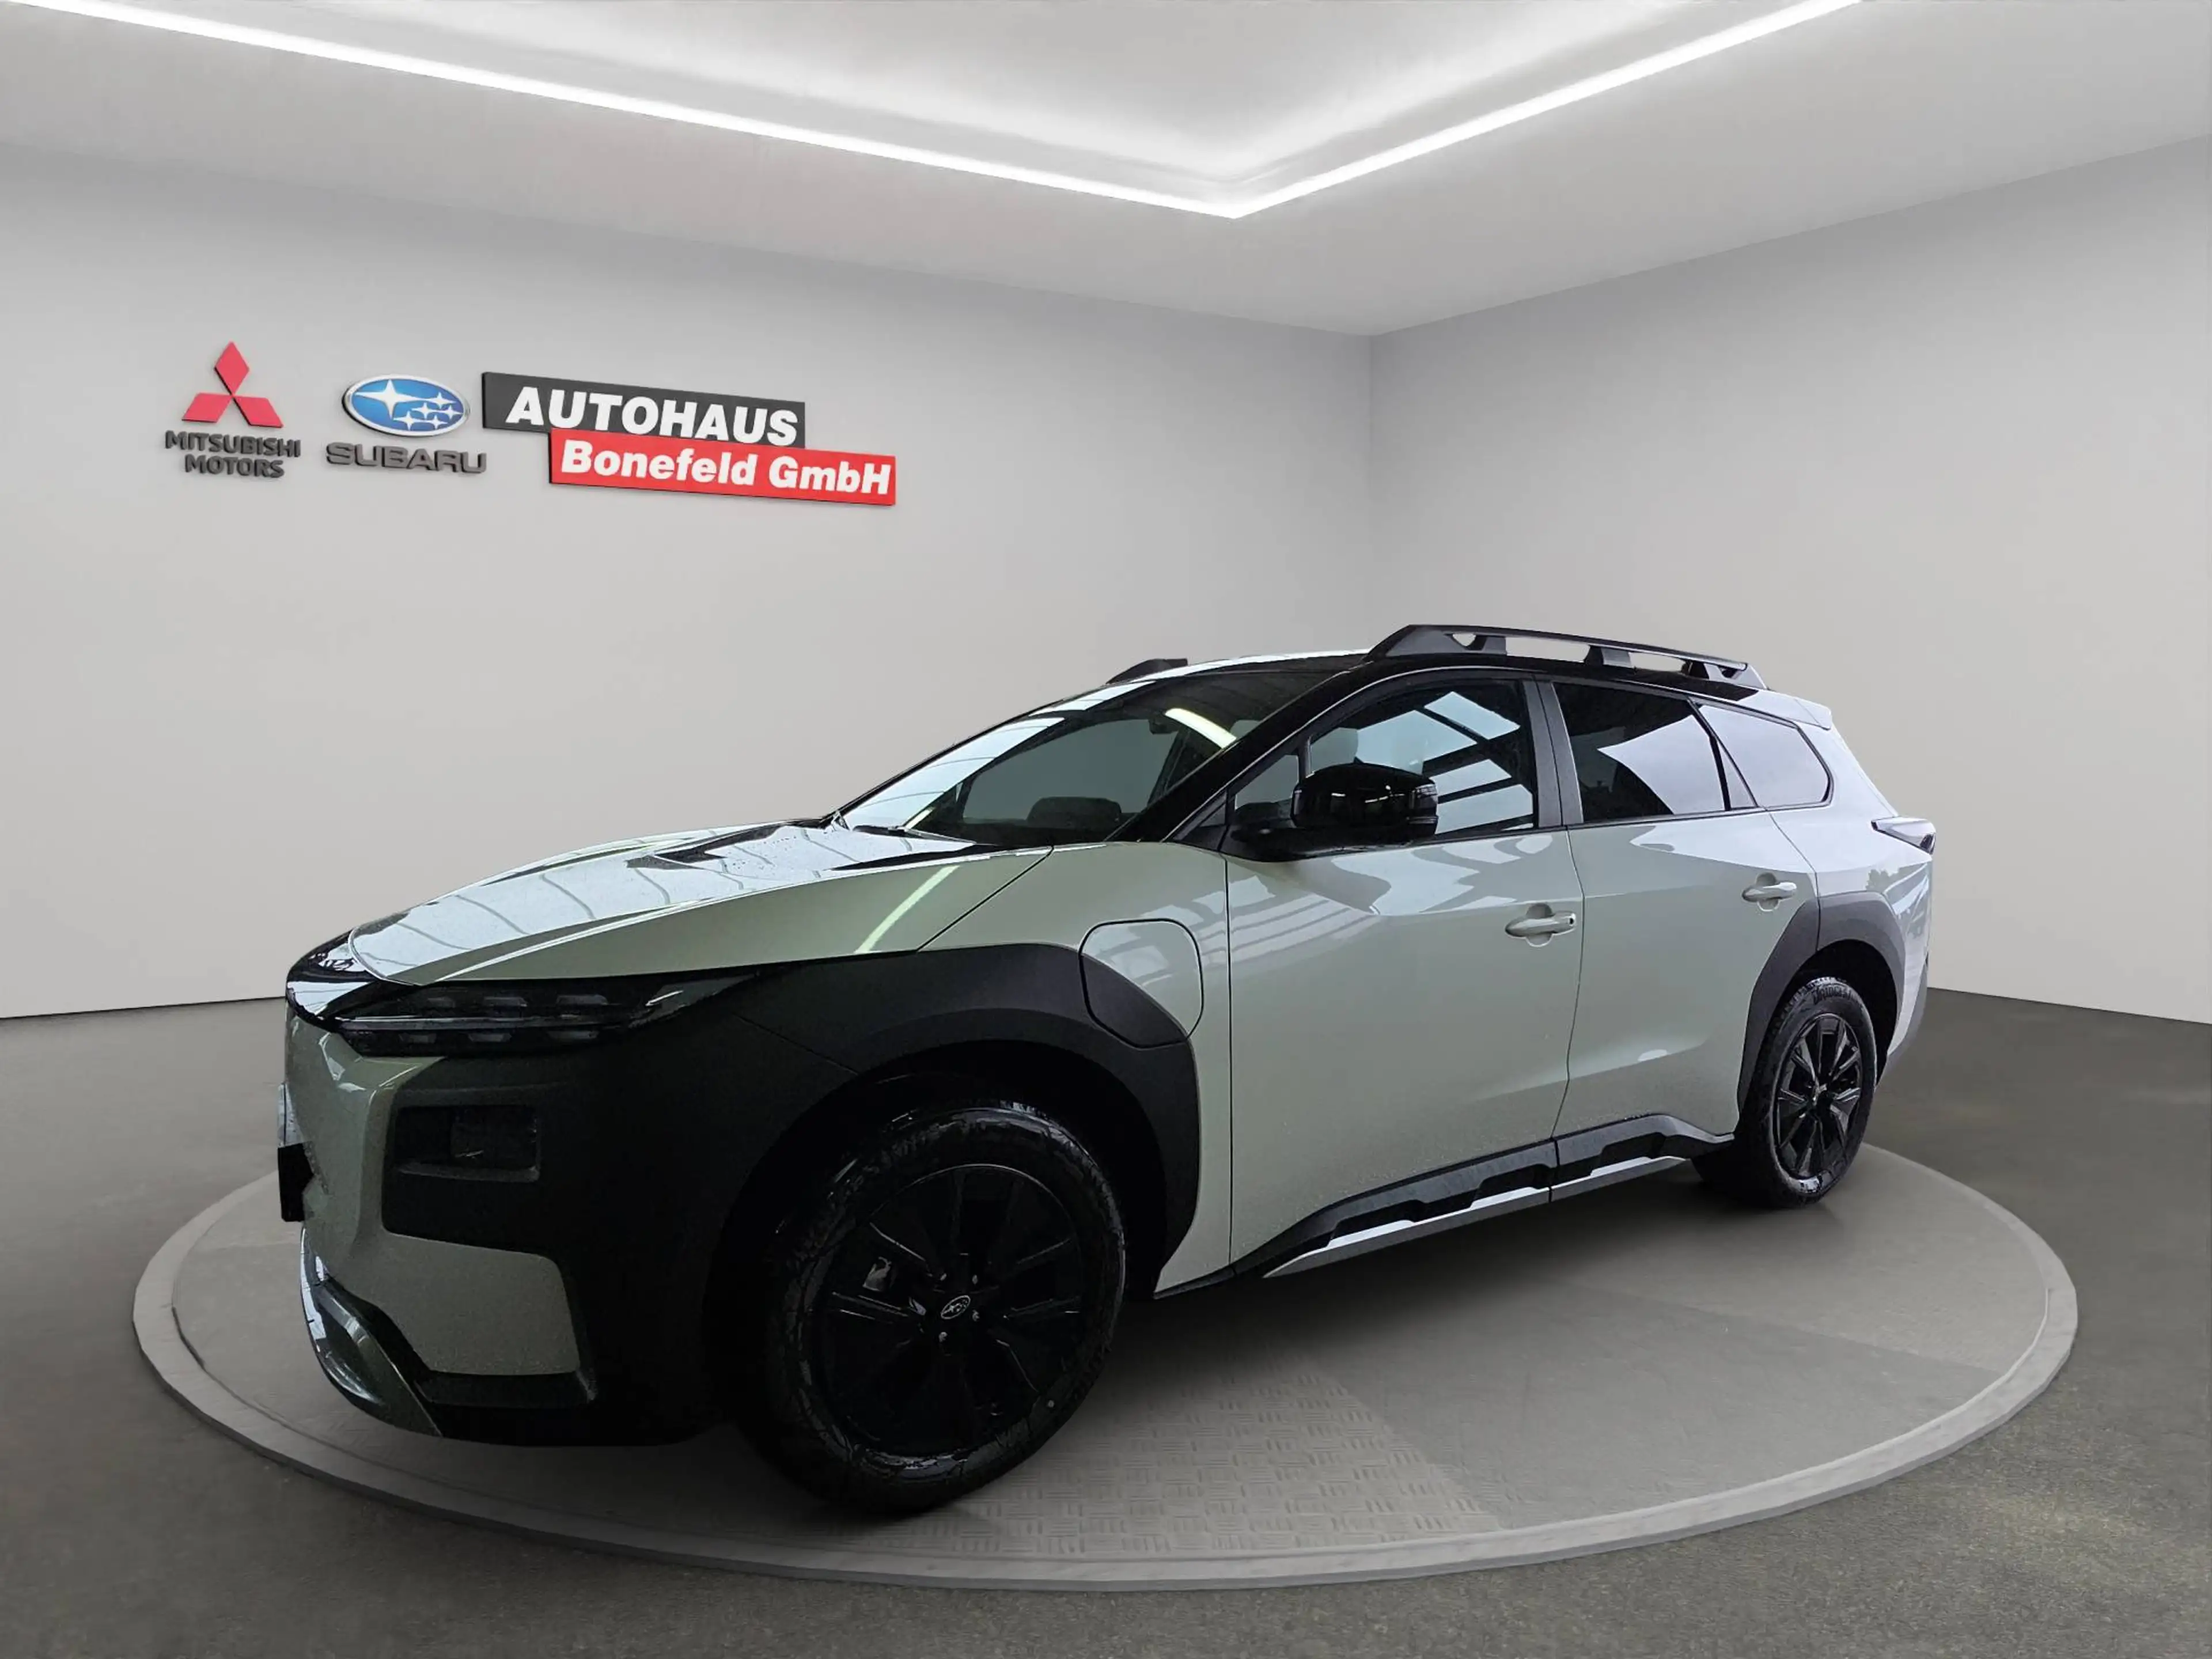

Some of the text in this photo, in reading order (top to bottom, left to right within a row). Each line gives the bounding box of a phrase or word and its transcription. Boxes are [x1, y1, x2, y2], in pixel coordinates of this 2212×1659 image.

[505, 386, 798, 447] AUTOHAUS
[165, 430, 301, 457] MITSUBISHI
[326, 442, 487, 474] SUBARU
[184, 454, 285, 478] MOTORS
[561, 440, 891, 495] Bonefeld GmbH
